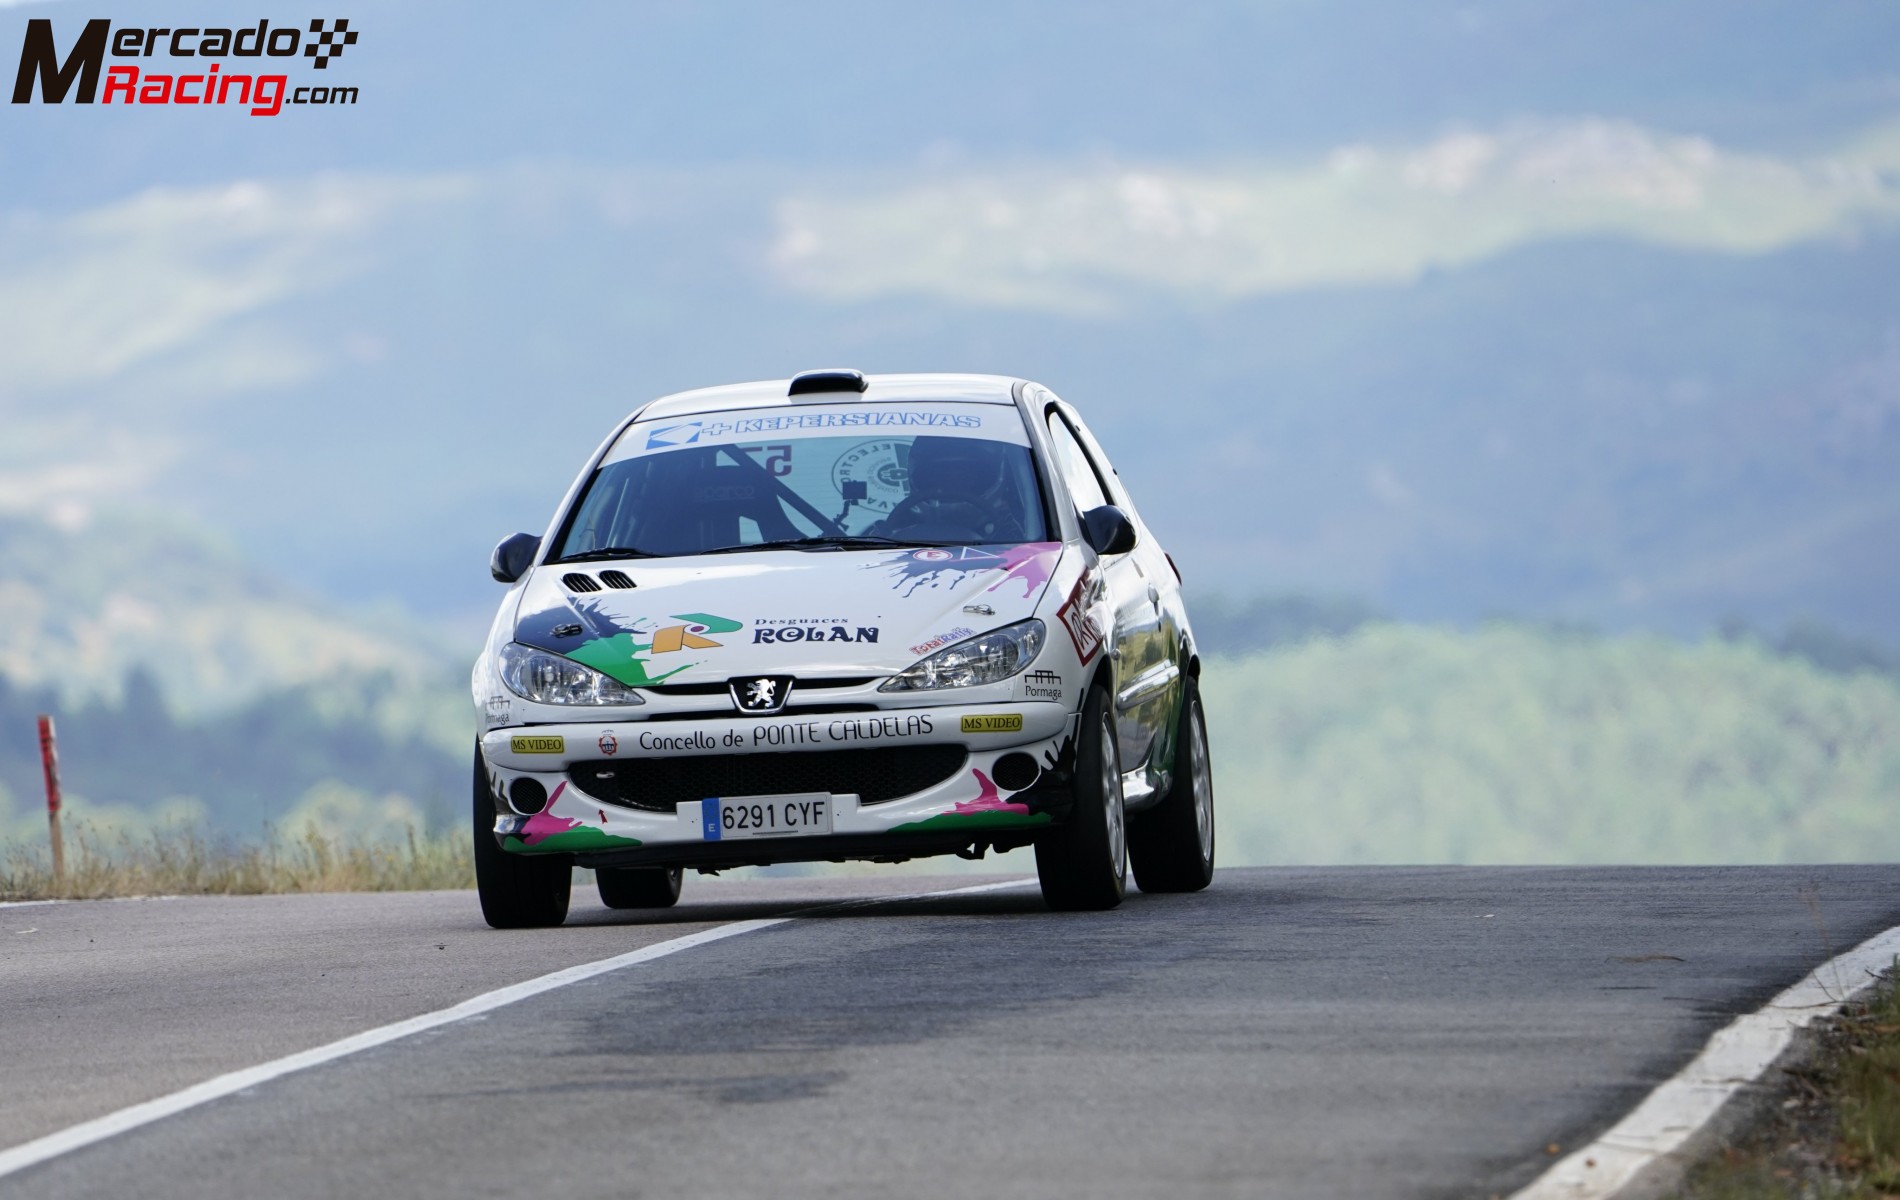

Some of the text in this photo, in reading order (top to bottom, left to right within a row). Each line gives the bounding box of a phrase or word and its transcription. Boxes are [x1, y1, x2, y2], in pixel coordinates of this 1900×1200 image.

[752, 626, 880, 644] ROLAN
[1025, 686, 1062, 700] Pormaga
[964, 717, 1020, 729] MS VIDEO
[639, 714, 934, 750] Concello de PONTE CALDELAS
[512, 739, 562, 750] MS VIDEO
[722, 801, 825, 830] 6291 CYF
[708, 823, 716, 832] E
